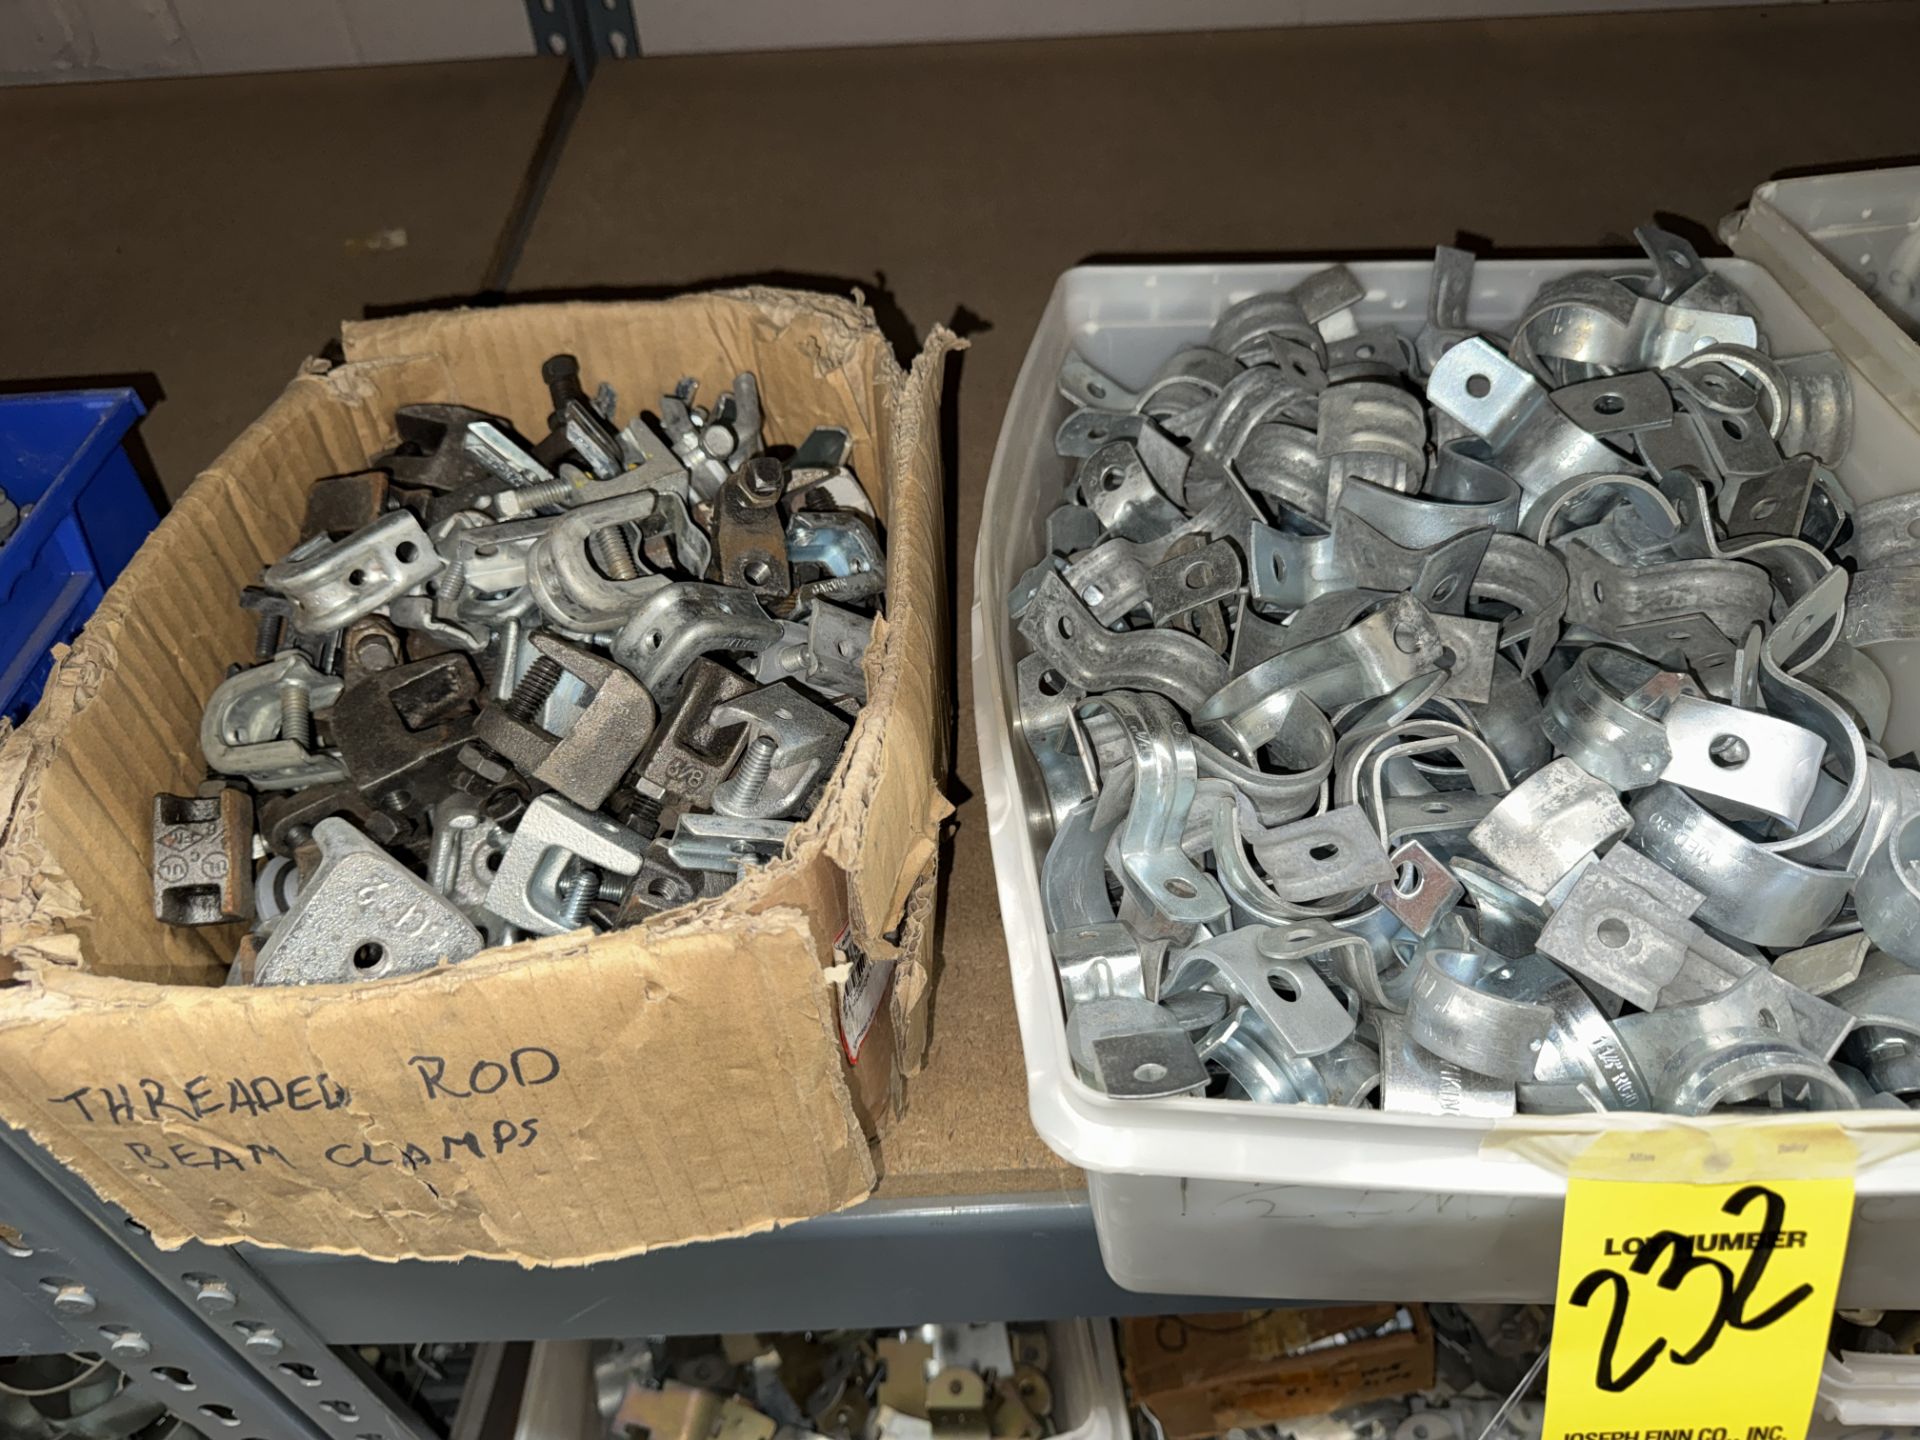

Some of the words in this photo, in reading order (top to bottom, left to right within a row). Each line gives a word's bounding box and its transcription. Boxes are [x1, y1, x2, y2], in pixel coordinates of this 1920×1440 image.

[47, 1072, 352, 1124] THREADED
[407, 1046, 561, 1101] ROD
[125, 1141, 296, 1172] BEAM
[324, 1118, 540, 1171] CLAMPS
[1604, 1236, 1661, 1256] LO
[1569, 1185, 1815, 1393] 232
